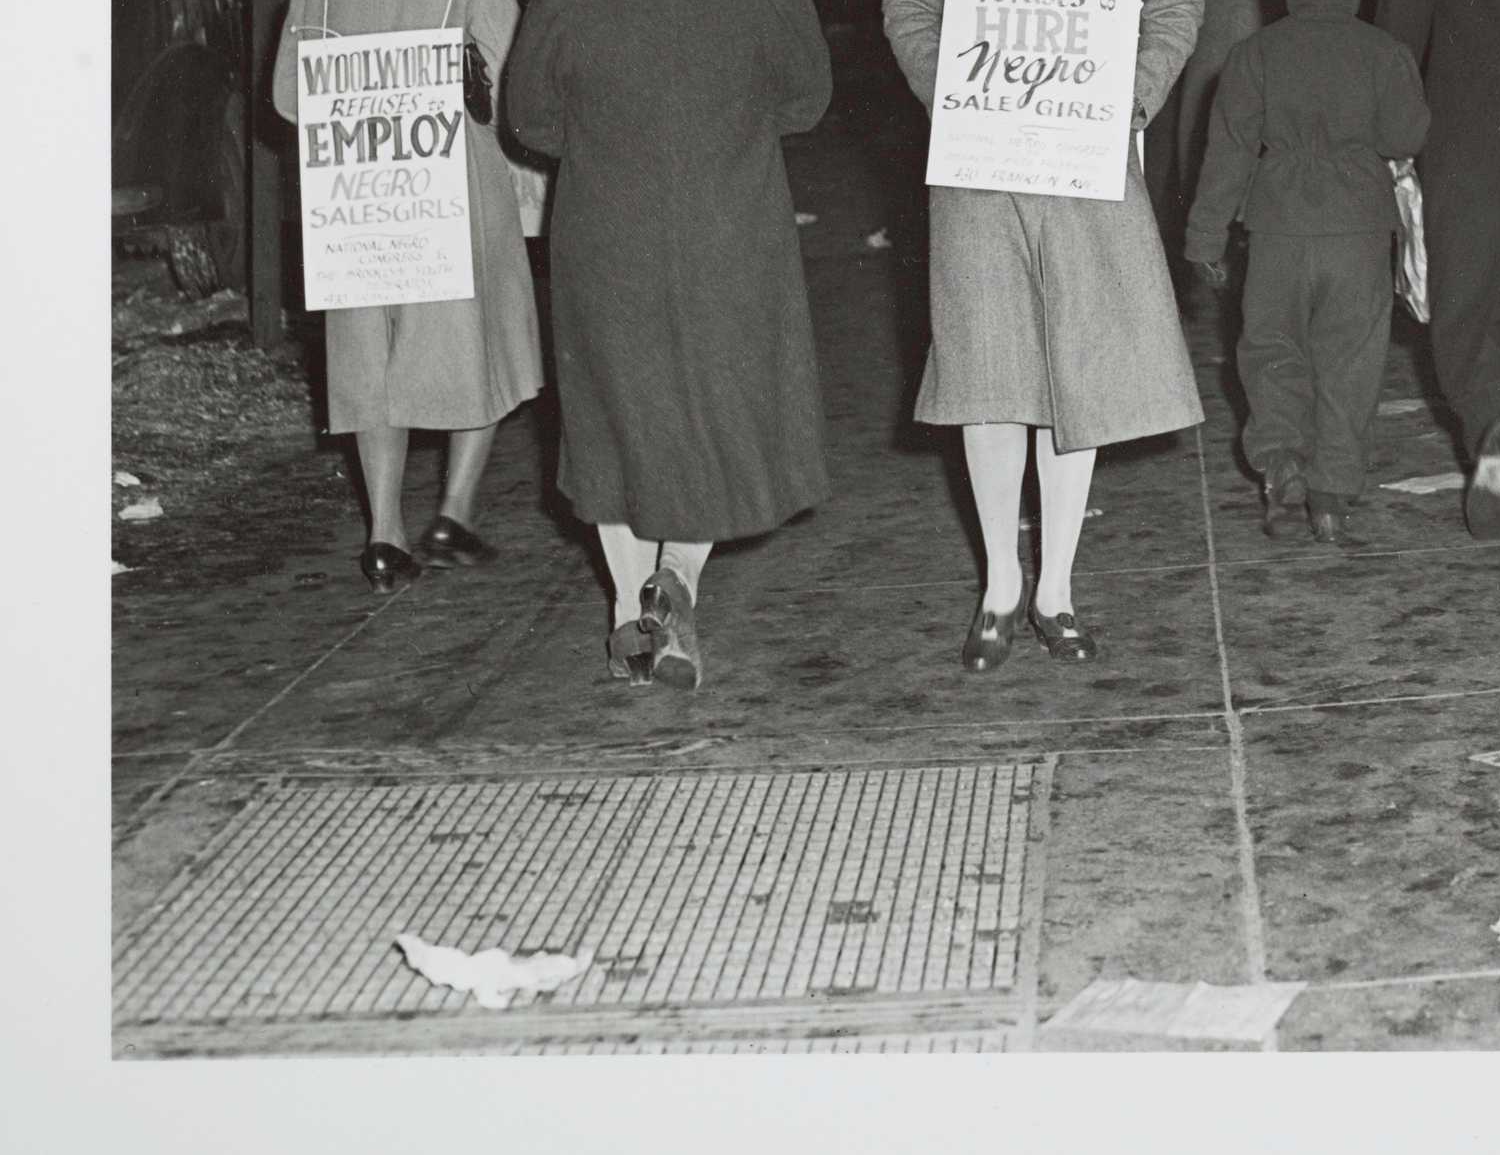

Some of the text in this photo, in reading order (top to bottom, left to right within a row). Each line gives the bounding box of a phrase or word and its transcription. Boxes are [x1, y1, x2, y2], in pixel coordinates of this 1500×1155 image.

[974, 6, 1091, 55] HIRE
[301, 42, 464, 96] WOOLWORTH
[957, 40, 1105, 109] Negro
[329, 92, 423, 118] REFUSES
[942, 92, 1116, 123] SALE GIRLS
[304, 109, 464, 168] EMPLOY
[329, 167, 432, 202] NEGRO
[310, 196, 466, 230] SALESGIRLS
